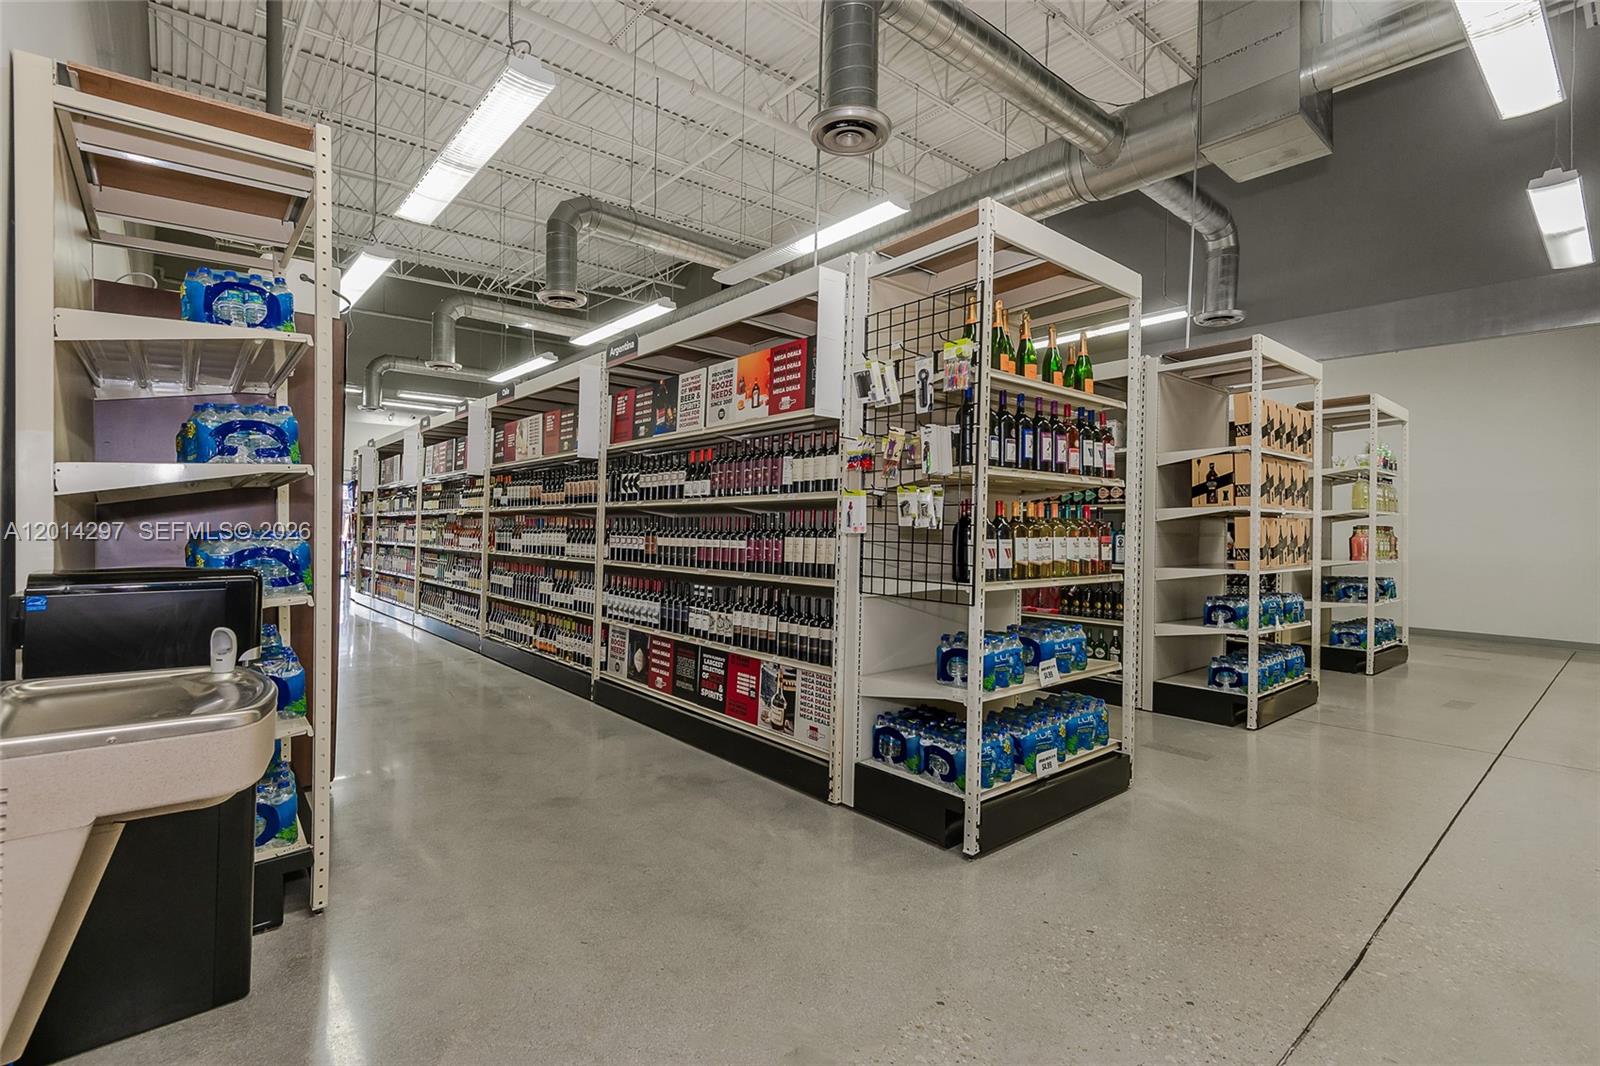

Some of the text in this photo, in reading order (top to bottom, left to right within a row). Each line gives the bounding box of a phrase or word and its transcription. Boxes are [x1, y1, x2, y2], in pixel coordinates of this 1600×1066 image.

[610, 341, 634, 356] Argentina
[711, 379, 733, 391] BOOZE
[680, 393, 695, 402] BEER
[711, 388, 732, 400] NEEDS
[704, 658, 724, 668] LARGEST
[702, 664, 724, 675] SELECTION
[816, 673, 832, 682] DEALS
[718, 684, 723, 693] &
[816, 680, 832, 688] DEALS
[701, 688, 723, 701] SPIRITS
[815, 686, 831, 694] DEALS
[815, 692, 831, 701] DEALS
[815, 699, 831, 707] DEALS
[815, 705, 831, 714] DEALS
[800, 713, 830, 726] MEGA DEALS
[814, 711, 830, 720] DEALS
